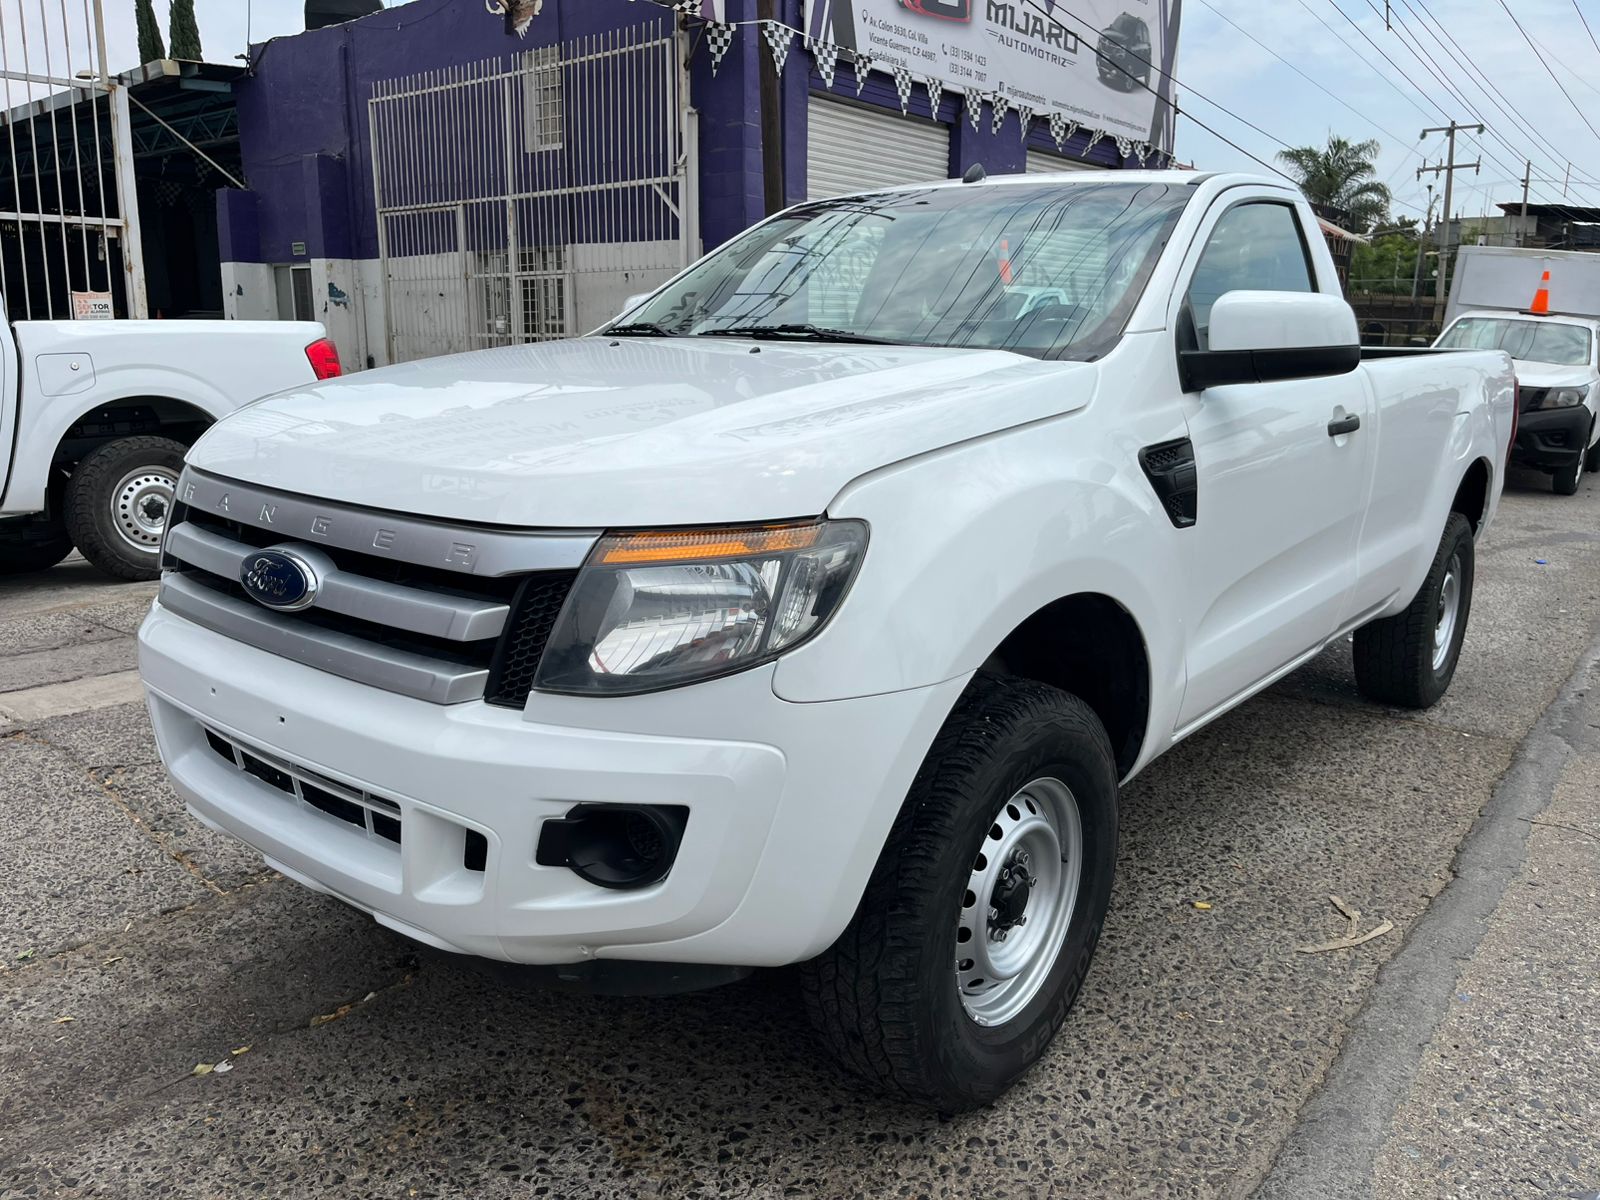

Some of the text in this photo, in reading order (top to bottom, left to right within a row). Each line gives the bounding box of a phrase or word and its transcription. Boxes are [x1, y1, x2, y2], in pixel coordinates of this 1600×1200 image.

[869, 31, 888, 47] Vicente
[917, 32, 929, 45] Villa
[986, 0, 1078, 55] MIJARO
[950, 45, 986, 67] (33) 1594 1423
[998, 34, 1068, 68] AUTOMOTRIZ
[949, 62, 959, 76] (33)
[960, 65, 972, 78] 3144
[183, 481, 477, 565] RANGER
[247, 556, 292, 596] Ford
